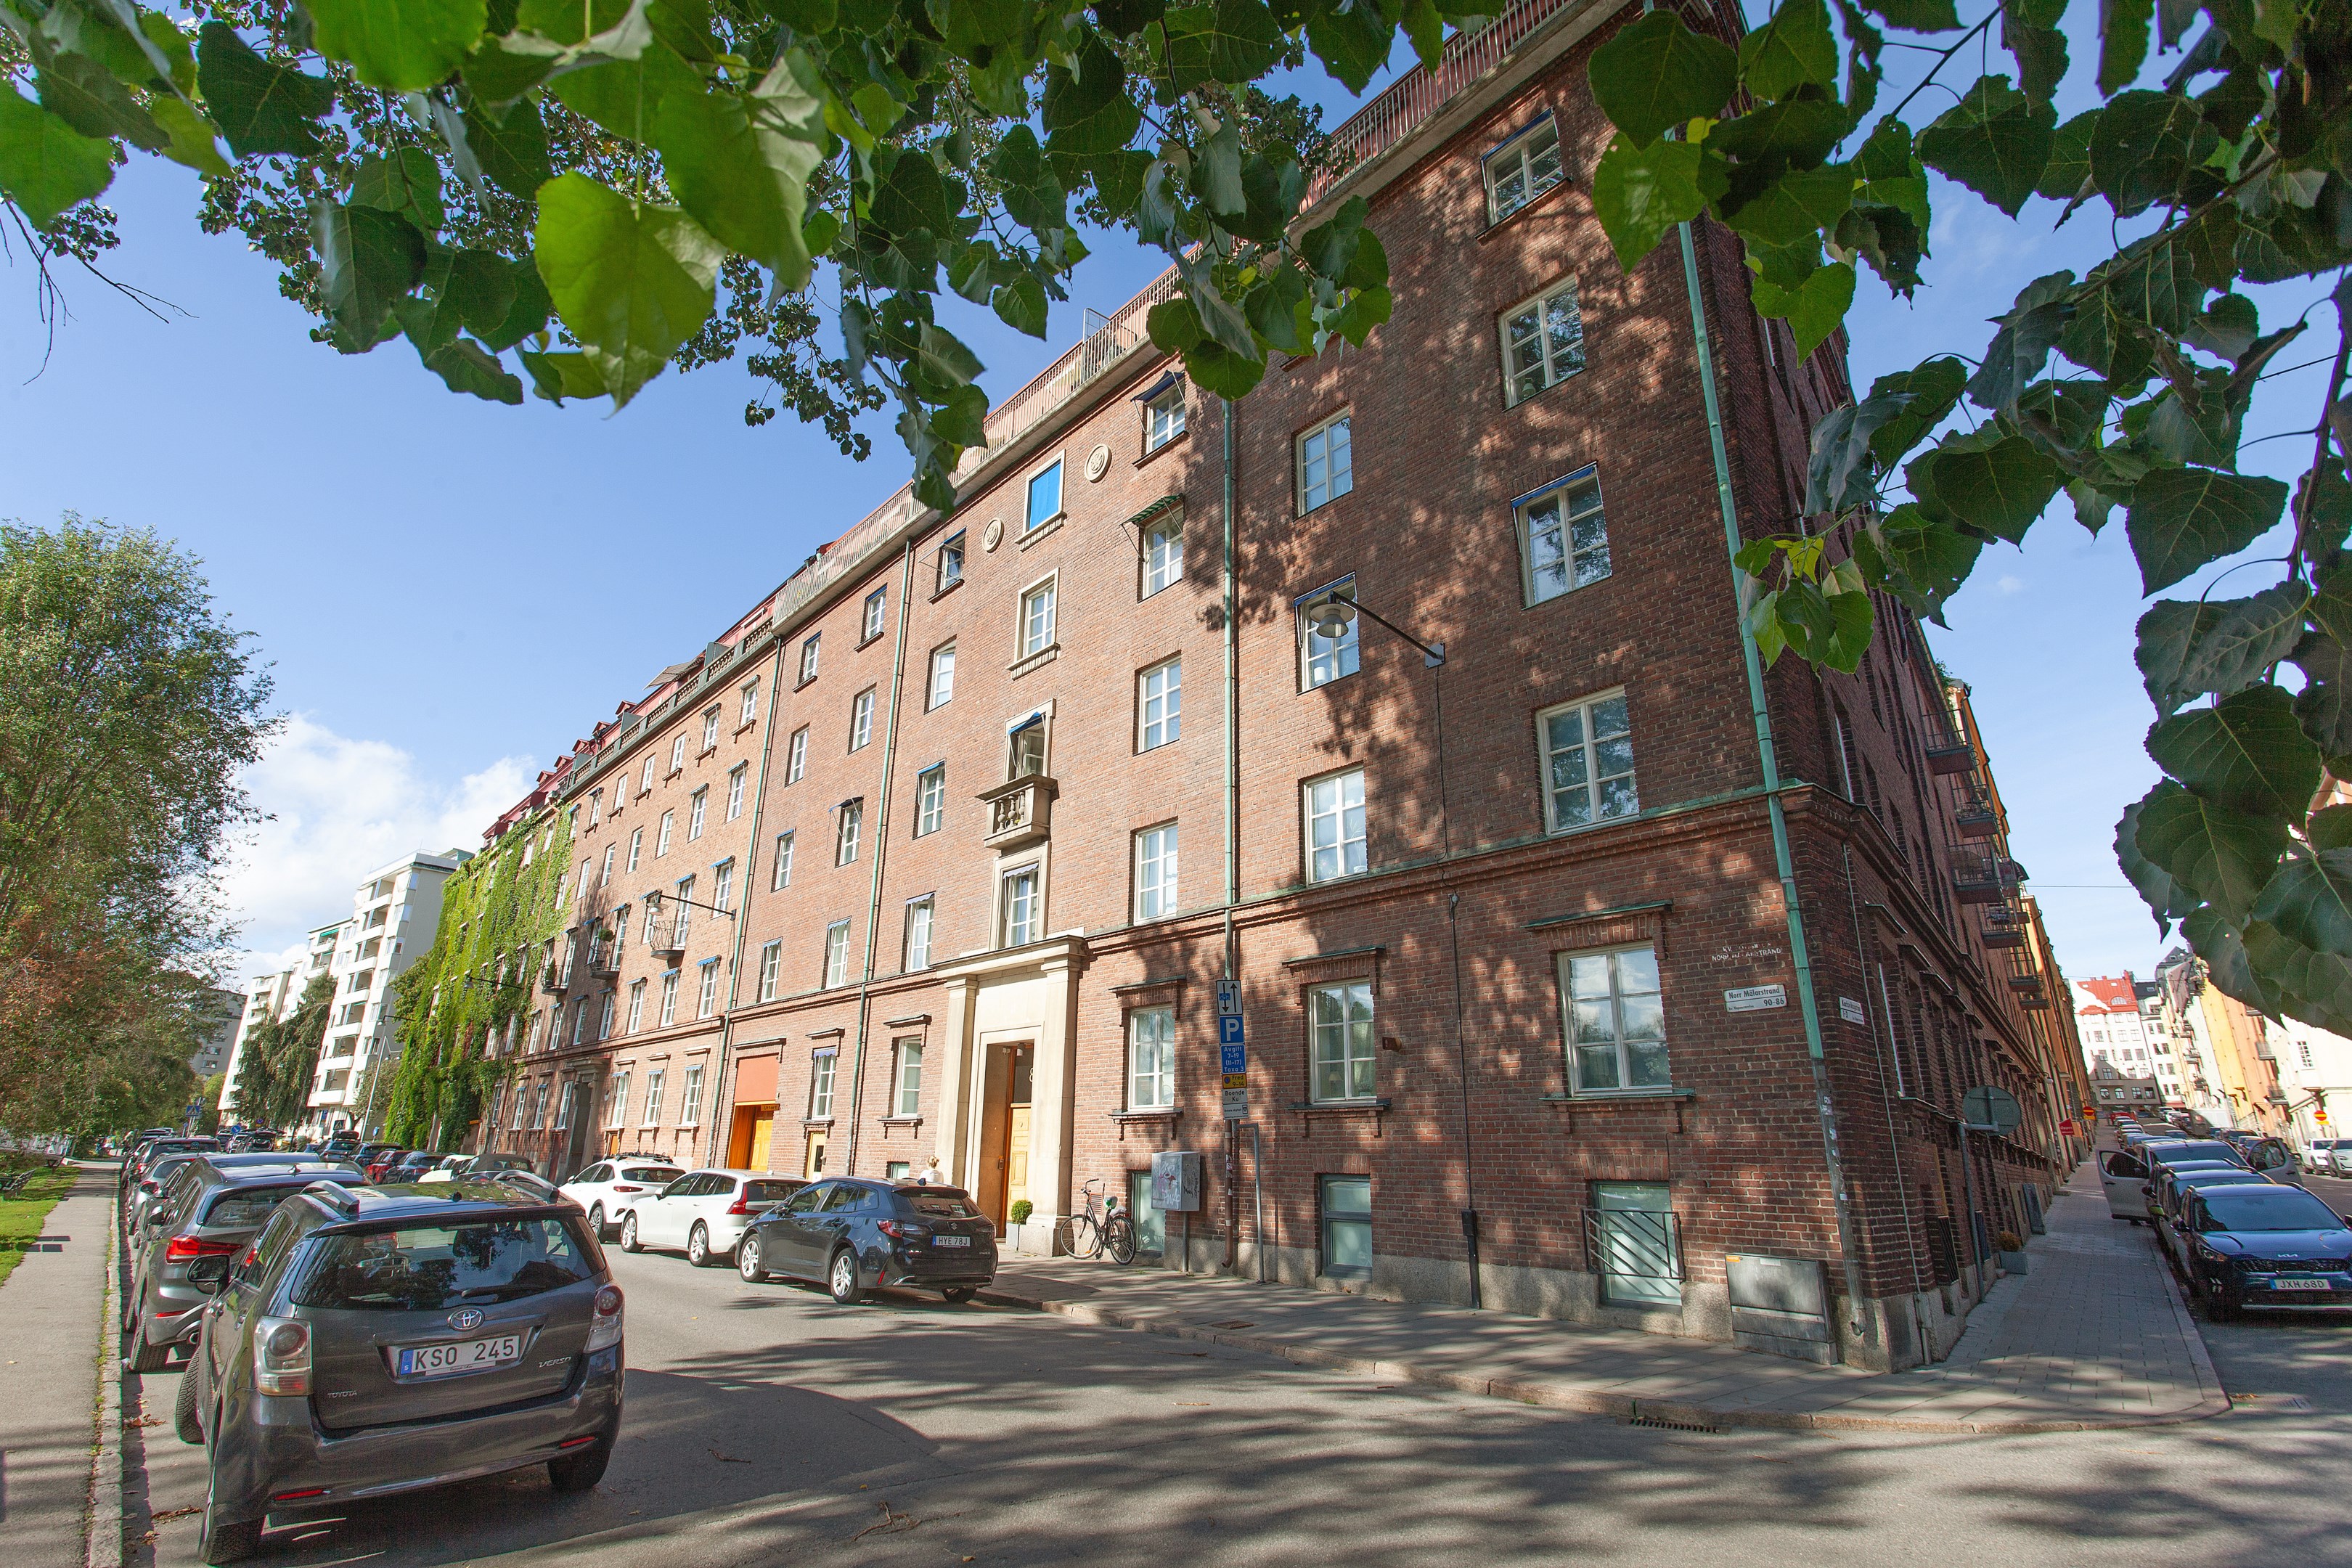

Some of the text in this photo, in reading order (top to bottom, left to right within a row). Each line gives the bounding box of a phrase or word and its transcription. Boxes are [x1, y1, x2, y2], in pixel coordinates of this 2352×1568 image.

[1744, 987, 1780, 997] Mälarstrand
[1763, 997, 1784, 1006] 90-86
[1225, 1018, 1240, 1042] P
[939, 1236, 968, 1246] HYE 78J
[2280, 1280, 2324, 1289] JXH 68D
[415, 1338, 514, 1371] KSO 245
[539, 1356, 572, 1368] VERSO
